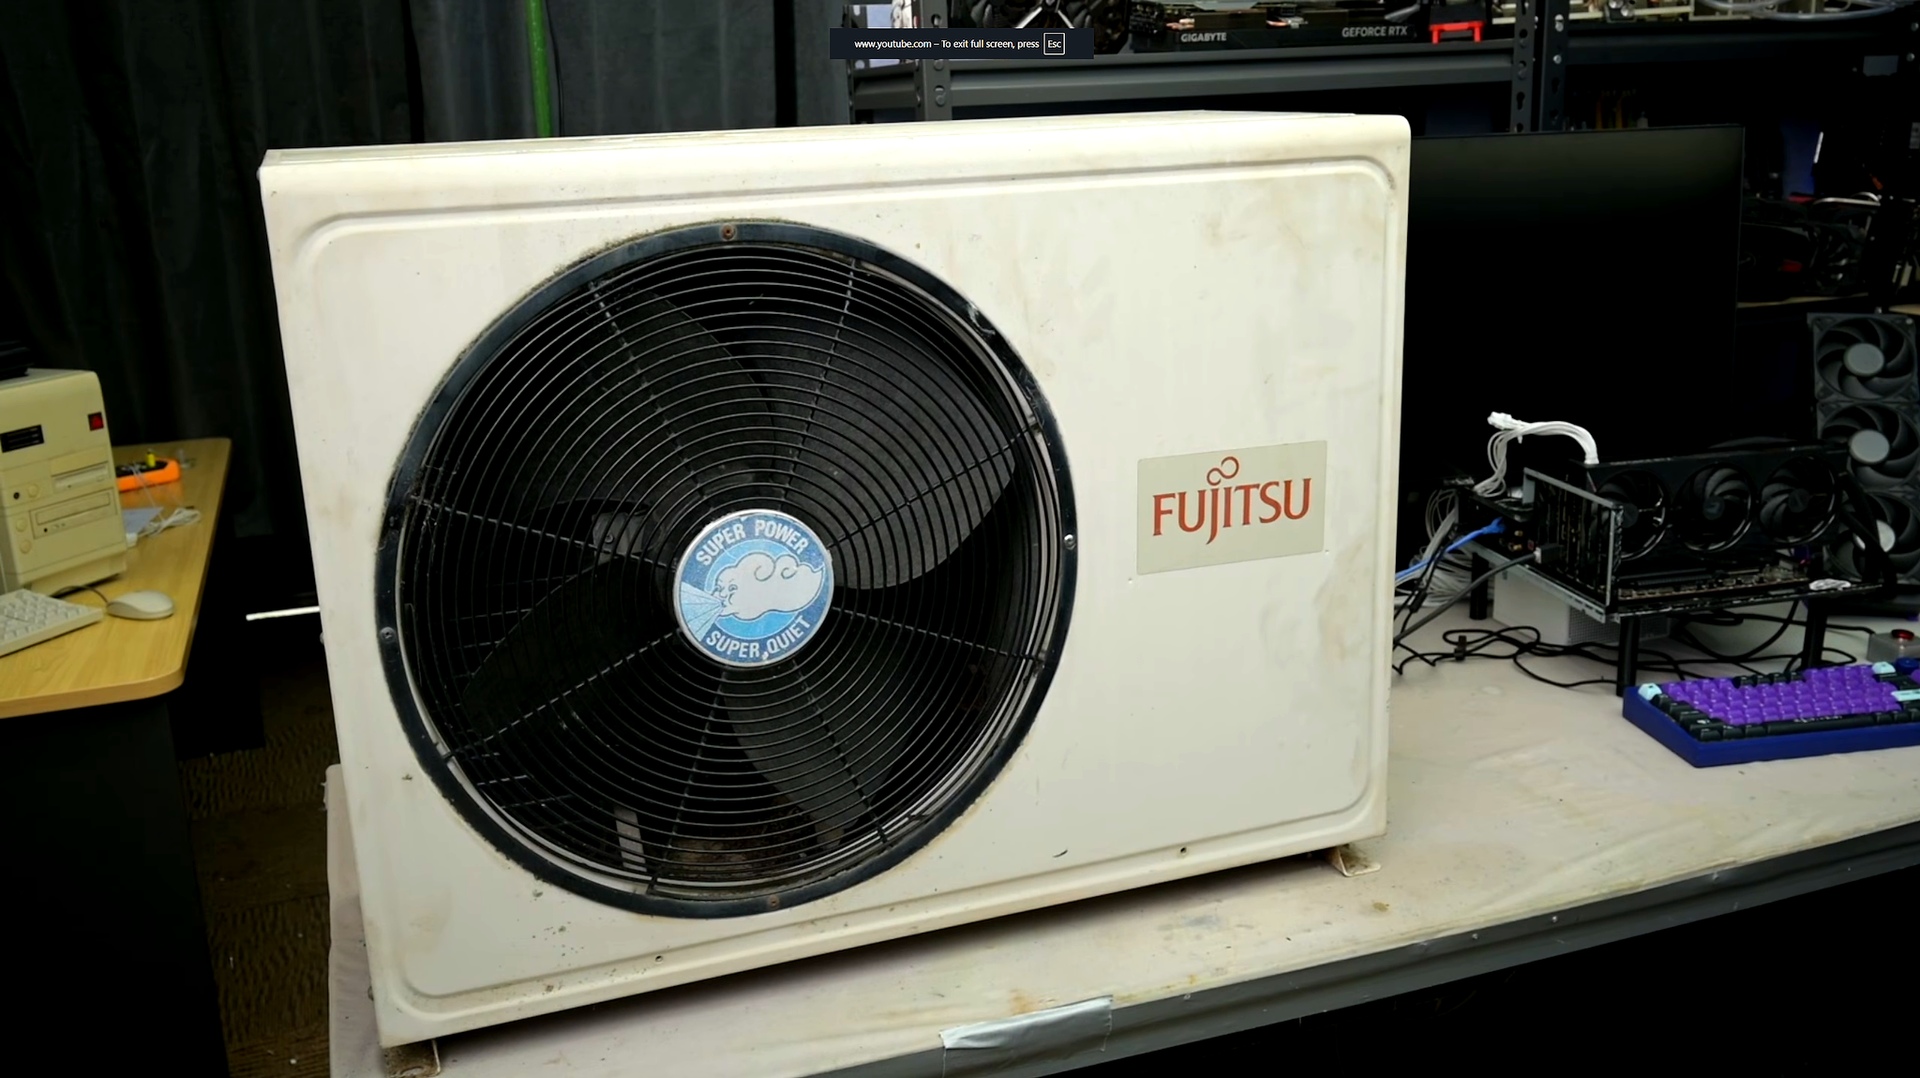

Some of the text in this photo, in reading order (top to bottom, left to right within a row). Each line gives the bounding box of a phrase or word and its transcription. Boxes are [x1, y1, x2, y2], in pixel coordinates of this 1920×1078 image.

[1180, 32, 1227, 42] GIGABYTE
[1341, 25, 1408, 38] GEFORCE RTX
[1152, 477, 1312, 545] FUJITSU
[696, 519, 809, 566] SUPER POWER
[706, 615, 811, 659] SUPER QUIET
